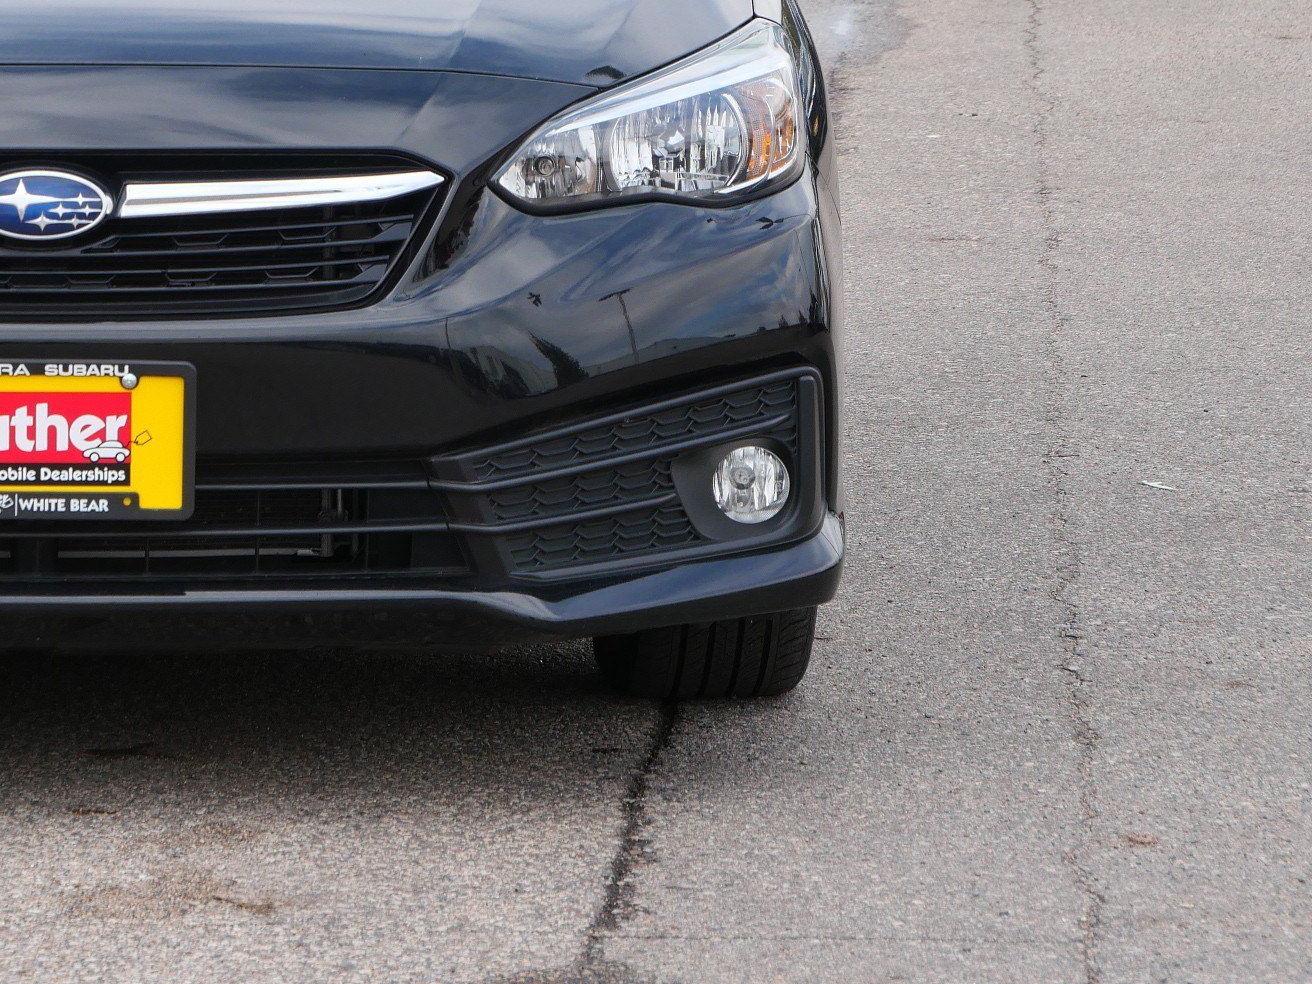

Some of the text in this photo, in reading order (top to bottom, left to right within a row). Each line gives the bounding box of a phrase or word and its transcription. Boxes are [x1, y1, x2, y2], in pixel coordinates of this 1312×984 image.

[44, 364, 130, 377] SUBARU
[40, 467, 126, 484] Dealerships
[18, 498, 66, 512] WHITE
[70, 499, 109, 512] BEAR
